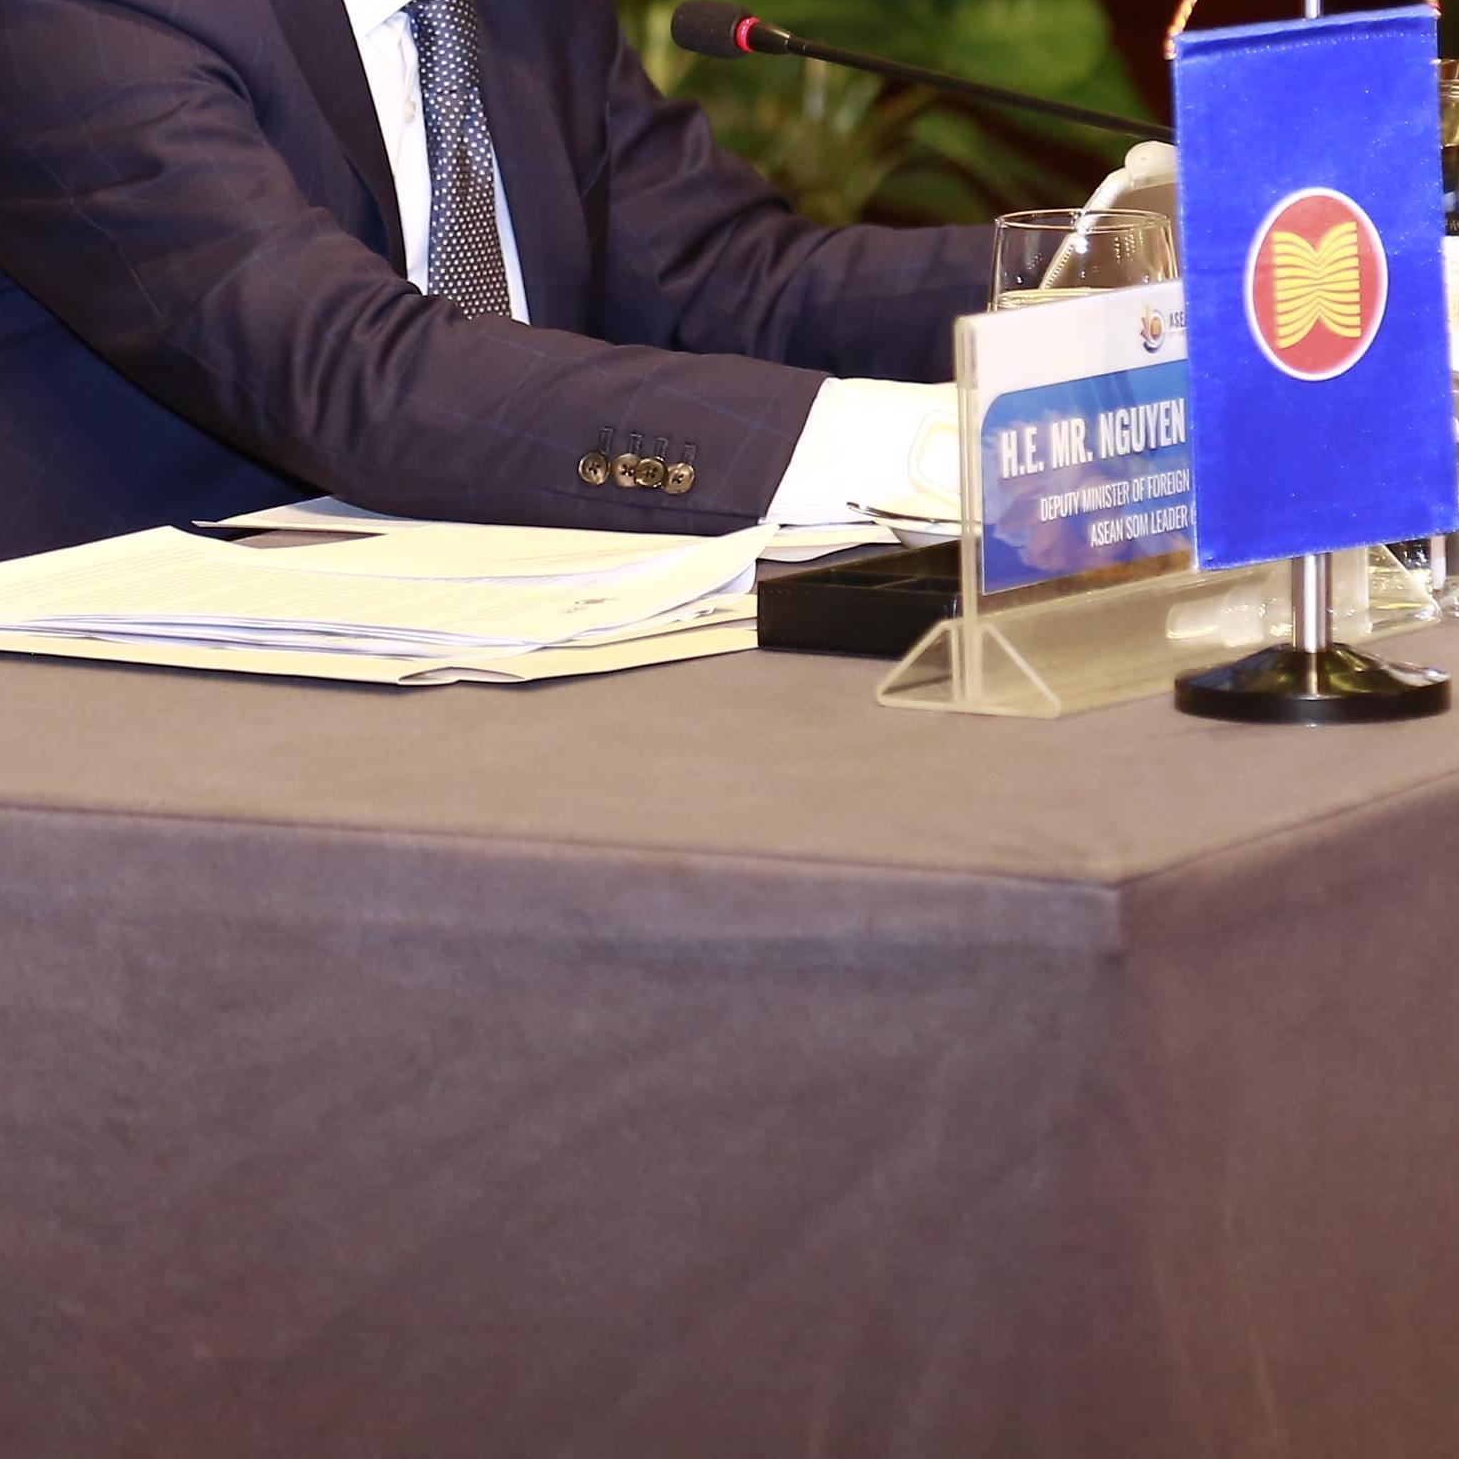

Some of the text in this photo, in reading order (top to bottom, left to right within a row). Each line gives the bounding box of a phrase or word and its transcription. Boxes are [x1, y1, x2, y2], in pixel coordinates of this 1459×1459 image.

[1168, 310, 1186, 329] ASE
[1001, 398, 1187, 479] H.E. MR. NGUYEN
[1040, 468, 1190, 522] DEPUTY MINISTER OF FOREIGN
[1090, 517, 1124, 548] ASEAN
[1125, 512, 1149, 540] SOM
[1151, 504, 1188, 535] LEADER
